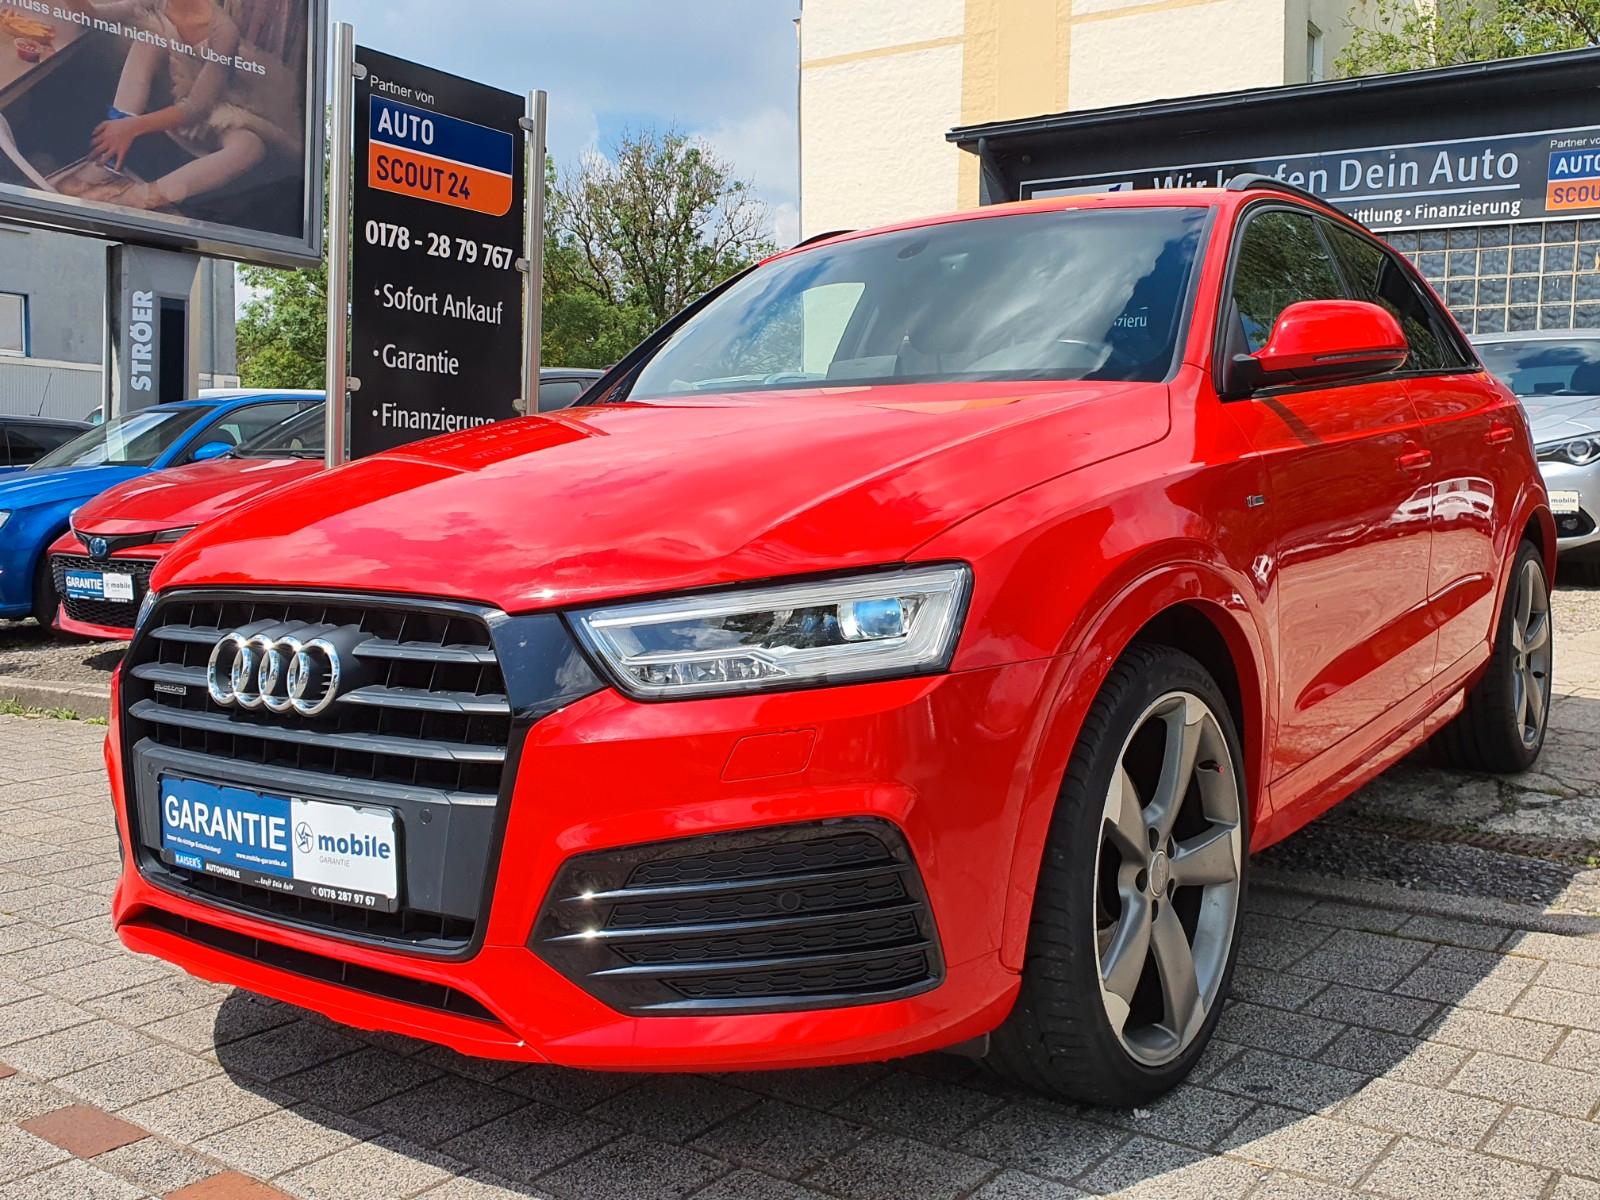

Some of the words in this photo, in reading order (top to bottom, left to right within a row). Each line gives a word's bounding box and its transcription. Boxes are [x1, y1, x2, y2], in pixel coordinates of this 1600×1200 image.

[53, 7, 91, 26] auch
[93, 18, 121, 35] mal
[124, 26, 167, 48] nichts
[170, 38, 196, 56] tun.
[201, 47, 232, 66] Uber
[234, 56, 266, 75] Eats
[370, 75, 412, 98] Partner
[415, 91, 435, 105] von
[377, 107, 434, 145] AUTO
[1550, 138, 1587, 149] Partner
[1339, 150, 1418, 192] Dein
[1429, 148, 1519, 184] Auto
[1348, 207, 1403, 225] ittlung
[1414, 199, 1521, 219] Finanzierung
[365, 220, 410, 250] 0178
[427, 232, 450, 258] 28
[455, 237, 477, 263] 79
[482, 243, 513, 270] 767
[383, 283, 438, 315] Sofort
[443, 294, 503, 325] Ankauf
[130, 290, 153, 391] STRÖER
[382, 343, 459, 376] Garantie
[382, 402, 496, 433] Finanzierun
[66, 576, 103, 590] GARANTIE
[164, 795, 287, 852] GARANTIE
[318, 833, 391, 859] mobile
[319, 855, 350, 867] GARANTIE
[205, 863, 240, 879] AUTOMOBILE
[318, 887, 336, 899] 0178
[337, 890, 352, 902] 287
[353, 893, 364, 904] 97
[365, 896, 376, 906] 67
